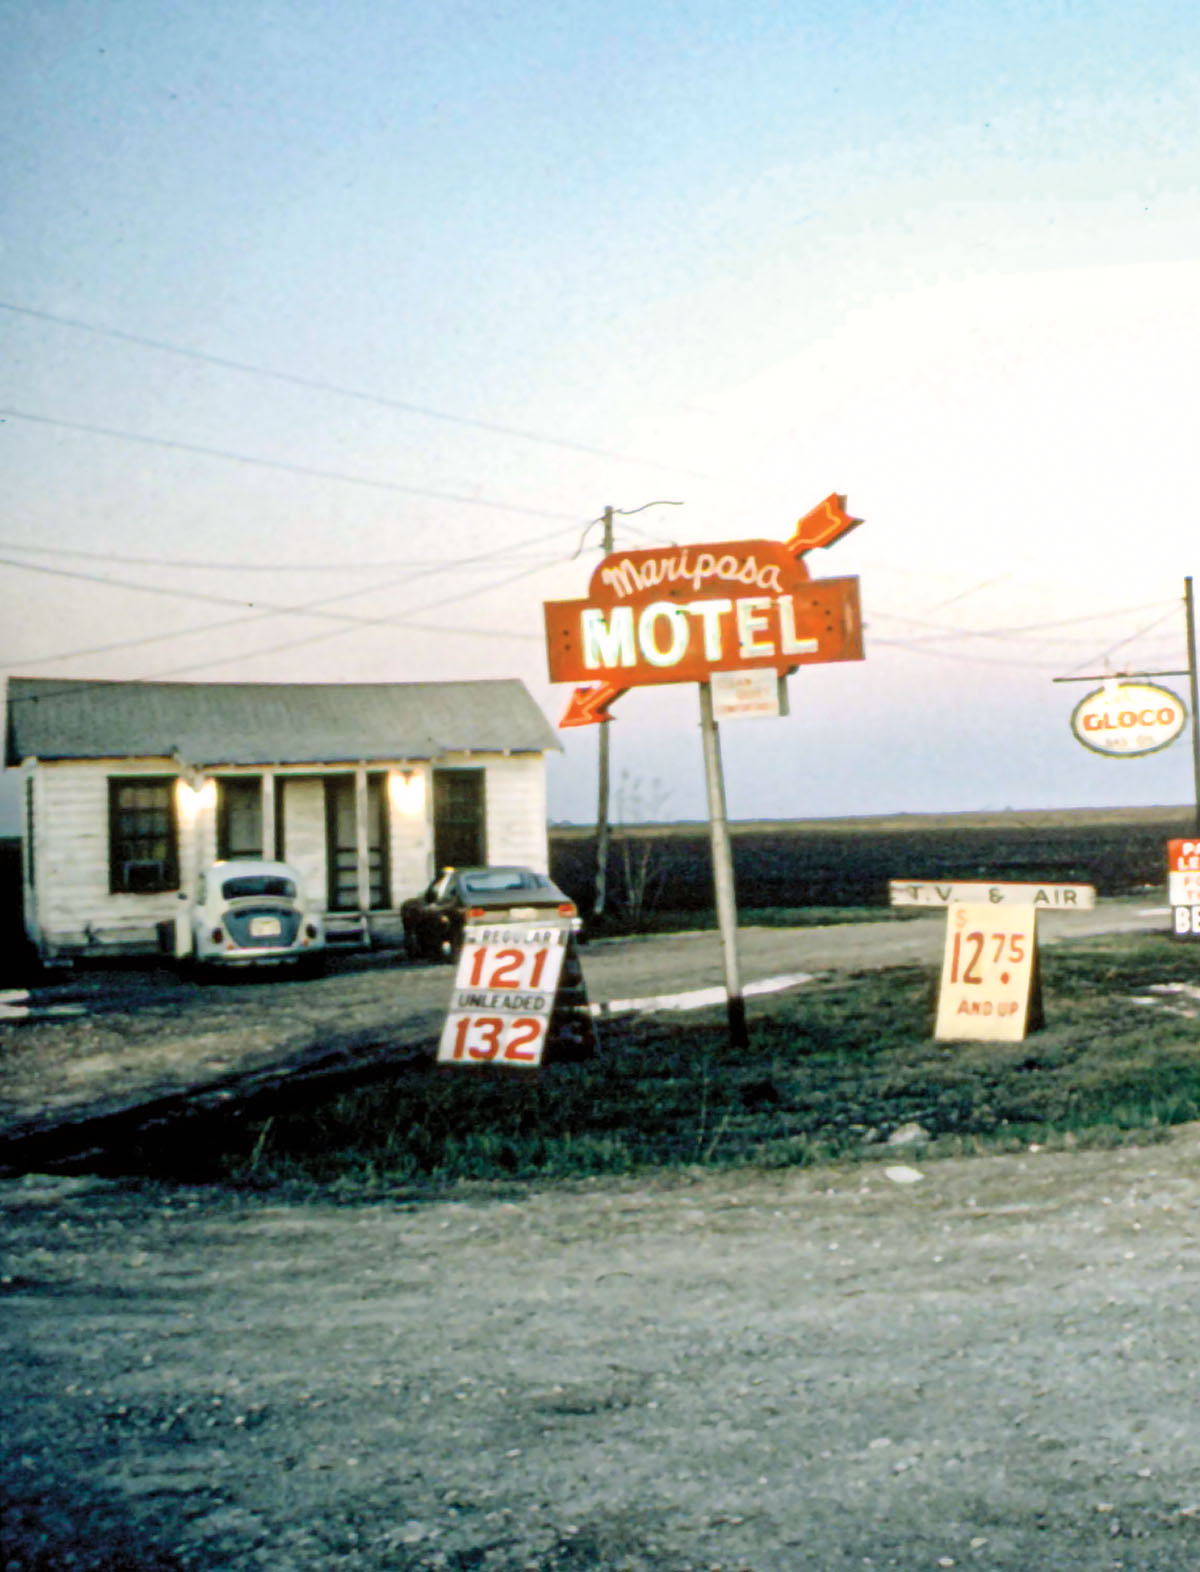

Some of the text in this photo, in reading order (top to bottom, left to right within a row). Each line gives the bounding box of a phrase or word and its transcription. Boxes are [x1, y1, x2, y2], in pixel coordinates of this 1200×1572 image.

[601, 549, 783, 598] Mariposa
[581, 595, 818, 669] MOTEL
[1082, 707, 1176, 731] GLOCO
[989, 887, 1004, 905] &
[1034, 888, 1077, 904] AIR
[482, 929, 552, 945] REGULAR
[470, 947, 549, 988] 121
[458, 994, 545, 1010] UNLEADED
[957, 999, 1019, 1017] AND UP
[453, 1016, 541, 1061] 132
